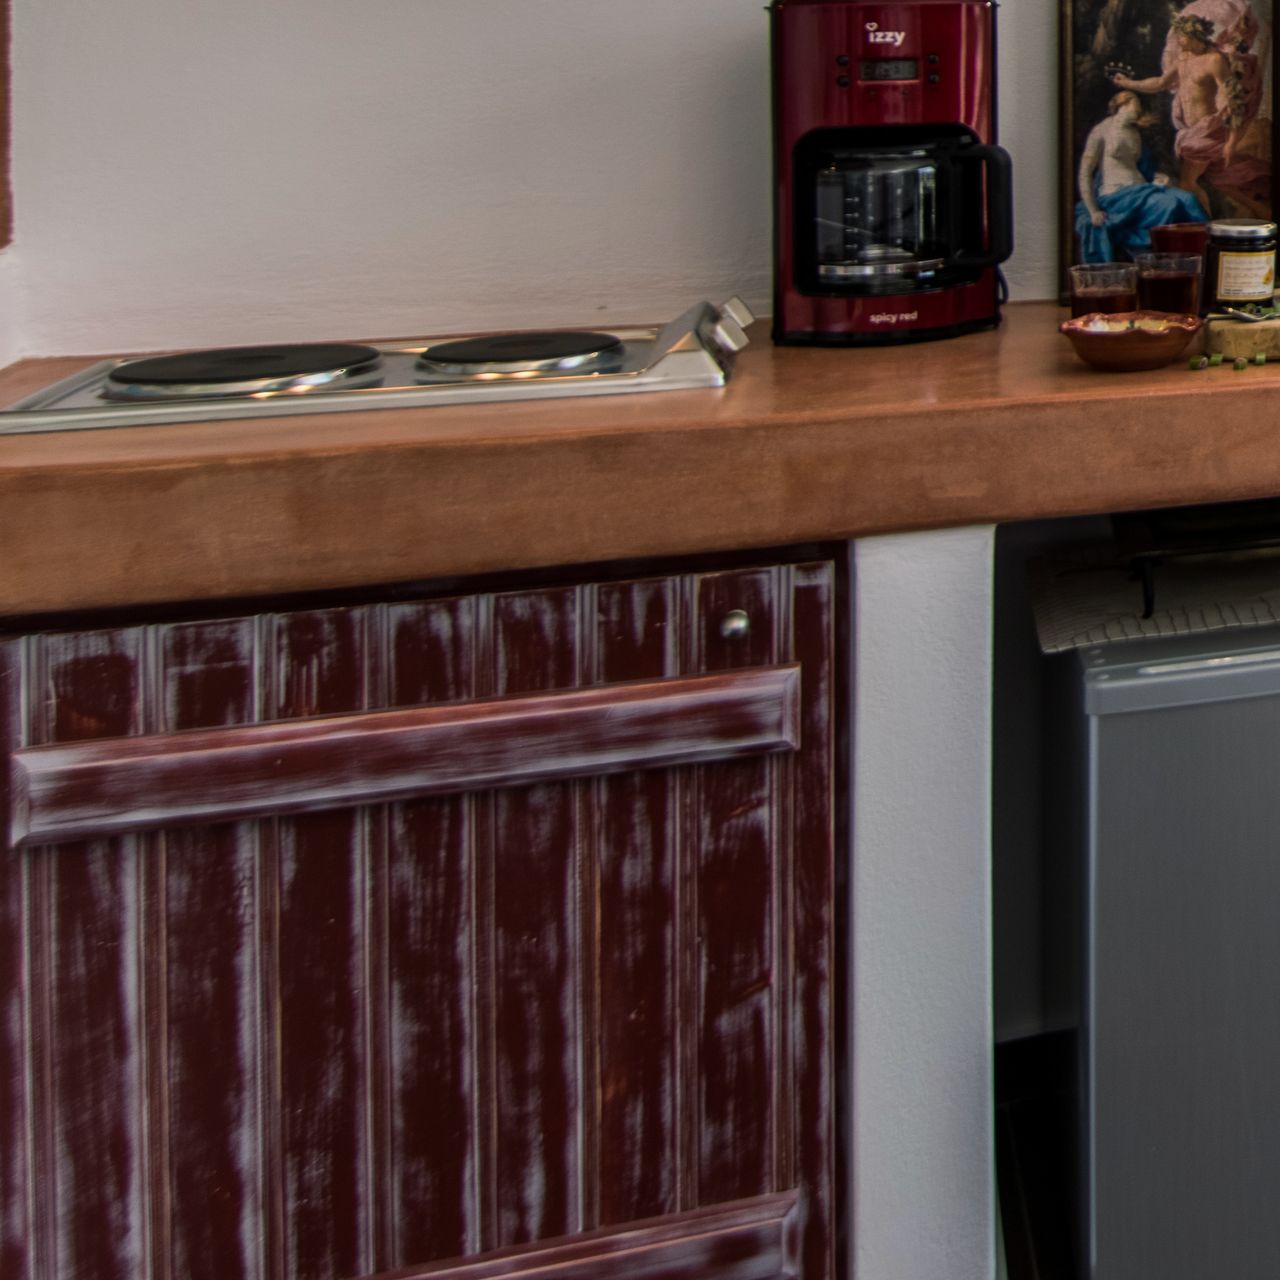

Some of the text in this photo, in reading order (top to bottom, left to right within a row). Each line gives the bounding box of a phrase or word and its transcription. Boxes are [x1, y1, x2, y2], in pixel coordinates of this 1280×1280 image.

[864, 22, 906, 47] izzy
[869, 310, 919, 325] spicy red
